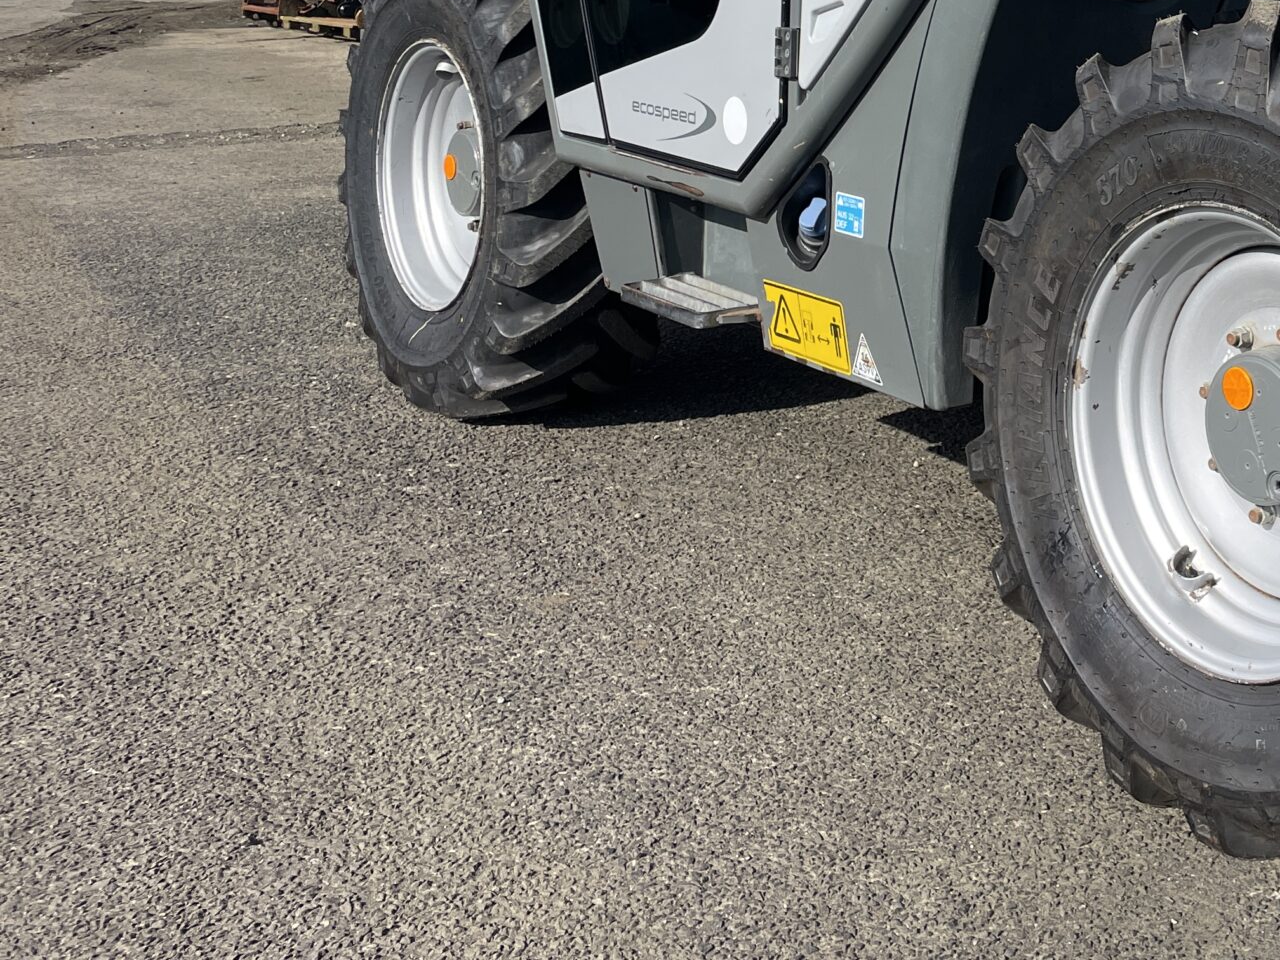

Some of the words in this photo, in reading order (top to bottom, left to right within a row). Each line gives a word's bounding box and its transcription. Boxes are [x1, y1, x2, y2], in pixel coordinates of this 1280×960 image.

[631, 99, 697, 124] ecospeed
[1096, 155, 1138, 206] 570
[1017, 262, 1062, 521] ALLIANCE
